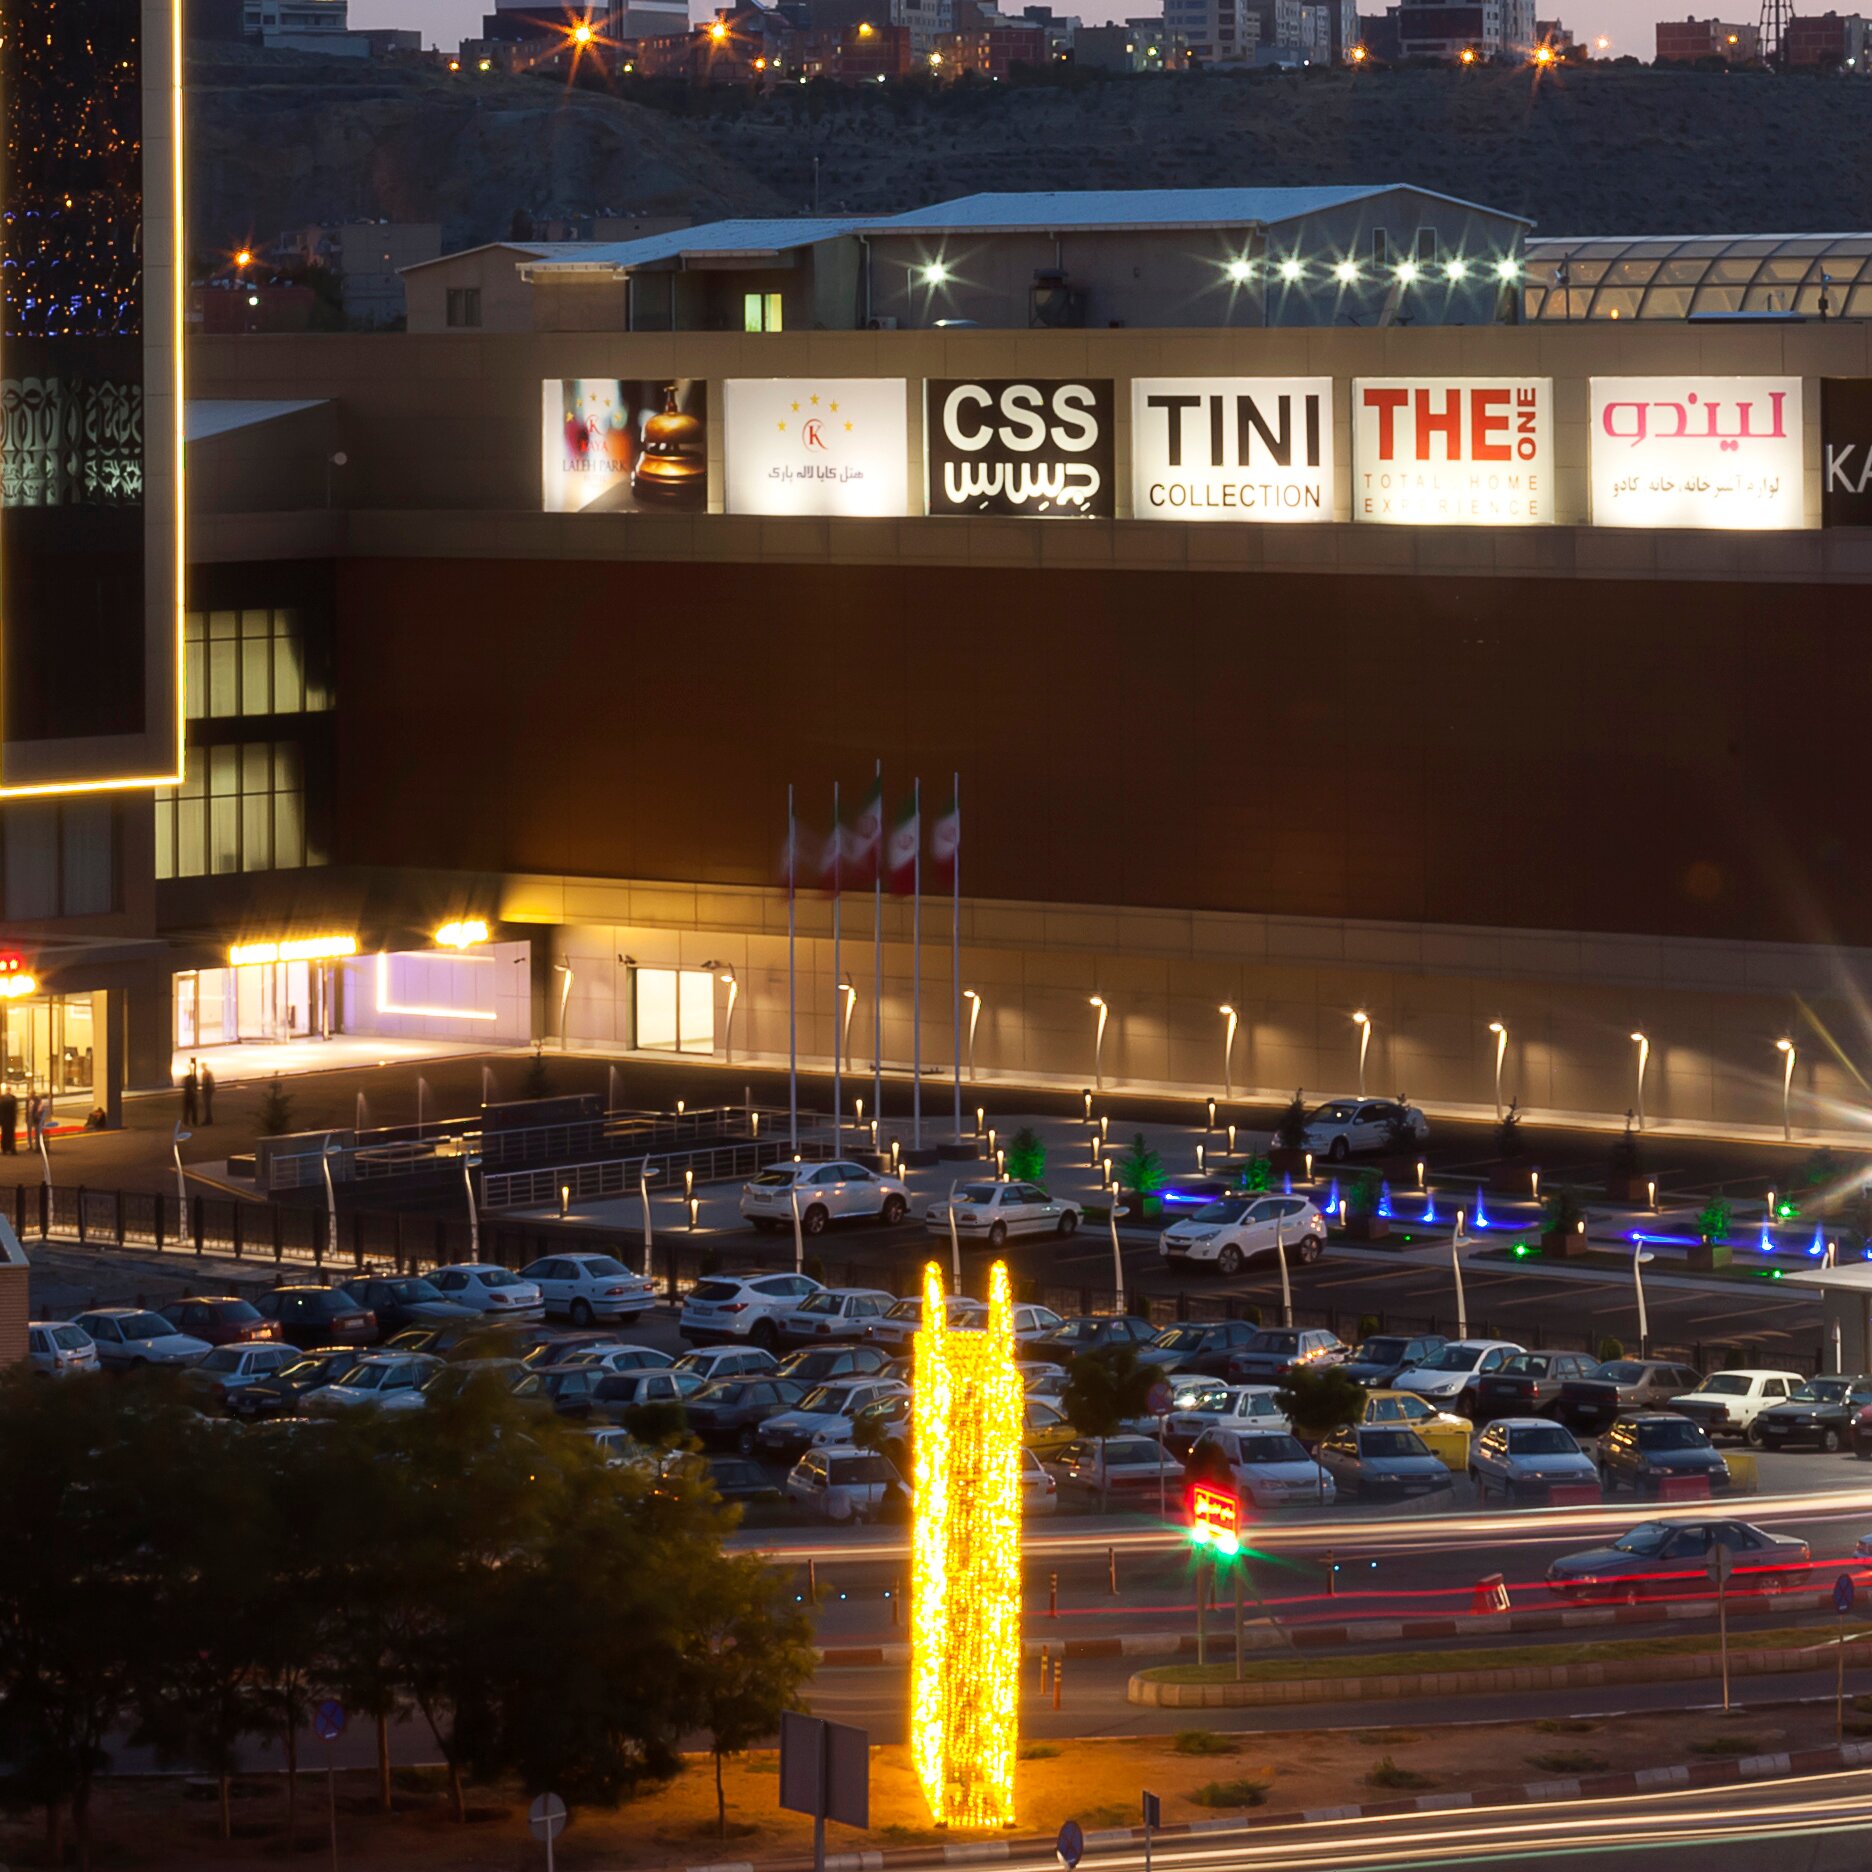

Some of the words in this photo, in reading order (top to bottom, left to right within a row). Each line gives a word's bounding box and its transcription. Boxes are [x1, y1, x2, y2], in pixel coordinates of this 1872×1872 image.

[943, 384, 1099, 452] CSS
[1147, 395, 1320, 467] TINI
[1363, 388, 1512, 461] THE
[1517, 387, 1537, 461] ONE
[1150, 483, 1320, 508] COLLECTION
[1363, 497, 1539, 516] EXPRIENCE
[1364, 473, 1441, 489] TOTAL
[1469, 474, 1539, 491] HOME
